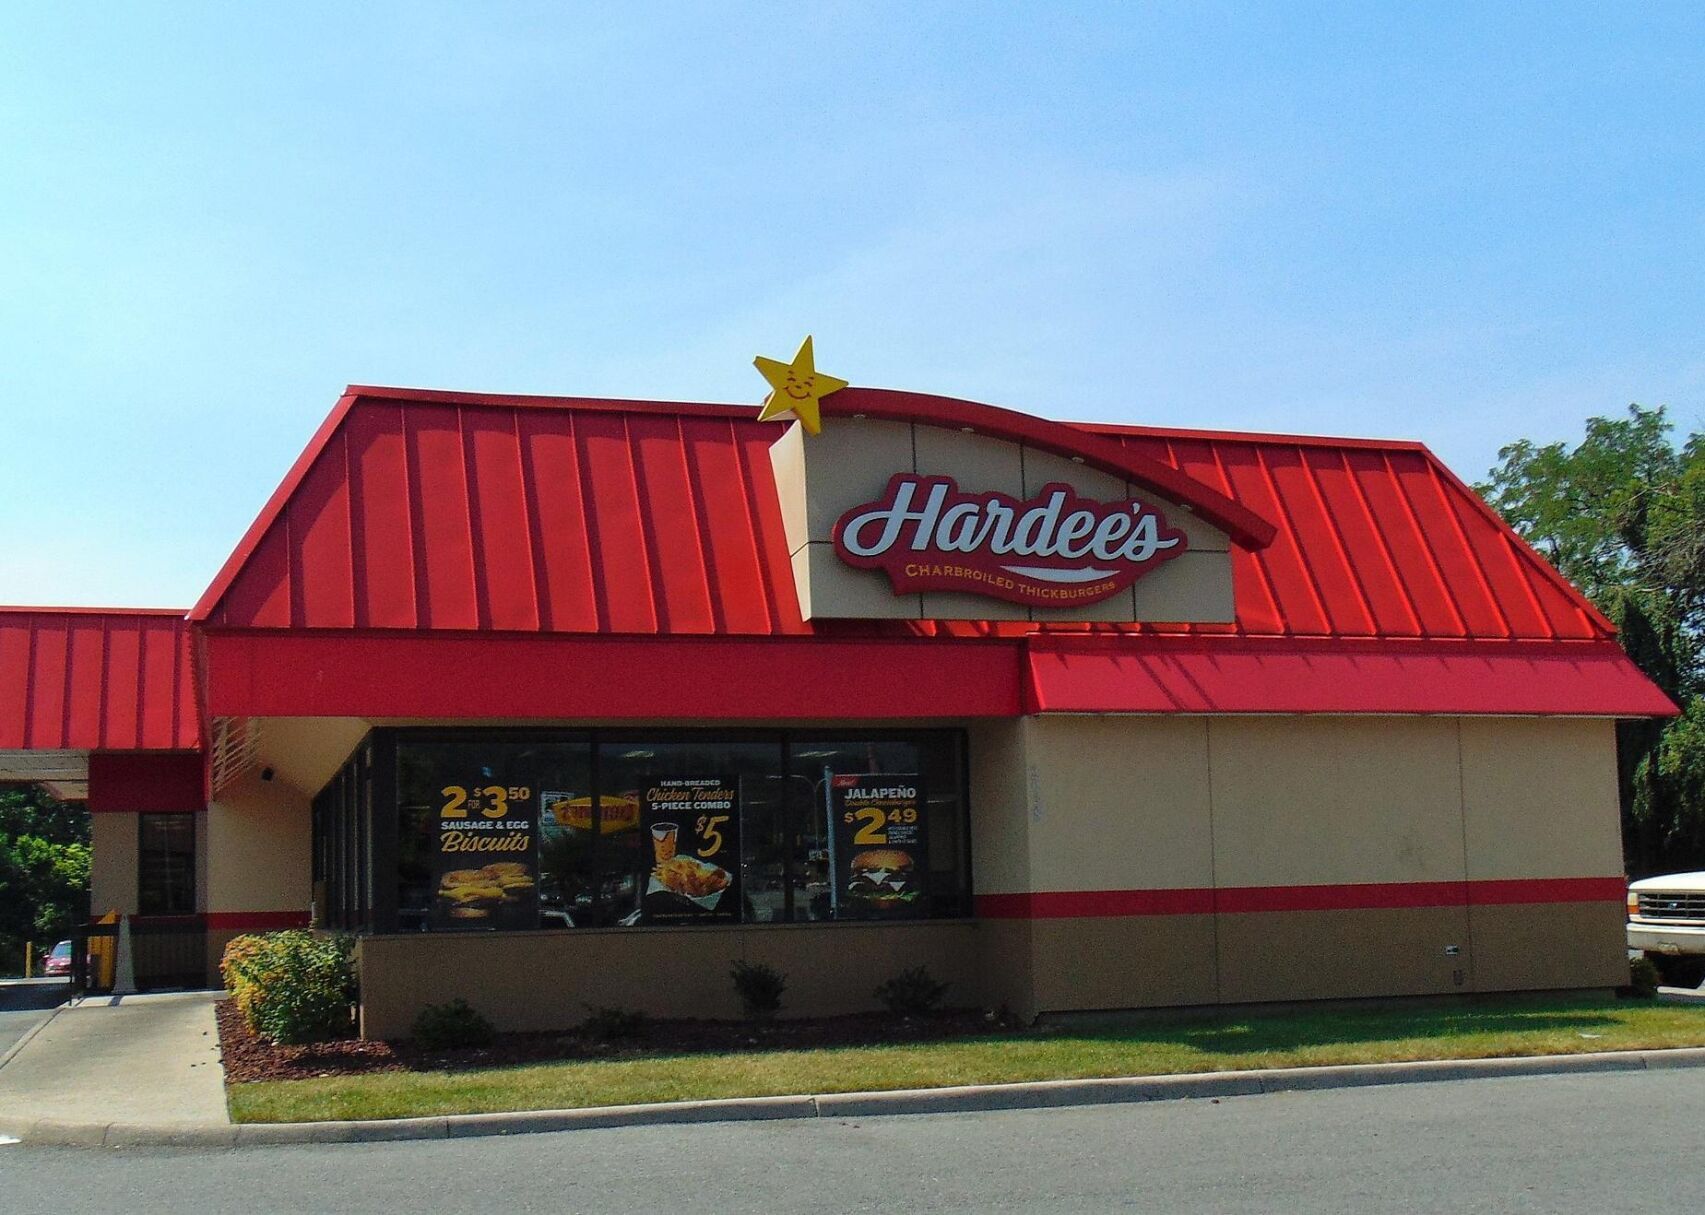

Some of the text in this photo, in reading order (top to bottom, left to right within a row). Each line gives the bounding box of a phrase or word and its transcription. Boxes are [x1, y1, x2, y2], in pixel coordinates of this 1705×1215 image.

[842, 482, 1179, 561] Hardee's
[905, 563, 1116, 599] CHARBROILED THICKBURGERS
[440, 785, 468, 818] 2
[646, 787, 735, 802] Chicken Tenders
[844, 785, 916, 799] JALAPEÑO
[651, 801, 731, 810] 5-PIECE COMBO
[440, 821, 529, 830] SAUSAGE & EGG
[695, 814, 730, 857] $5
[439, 830, 530, 852] Biscuits
